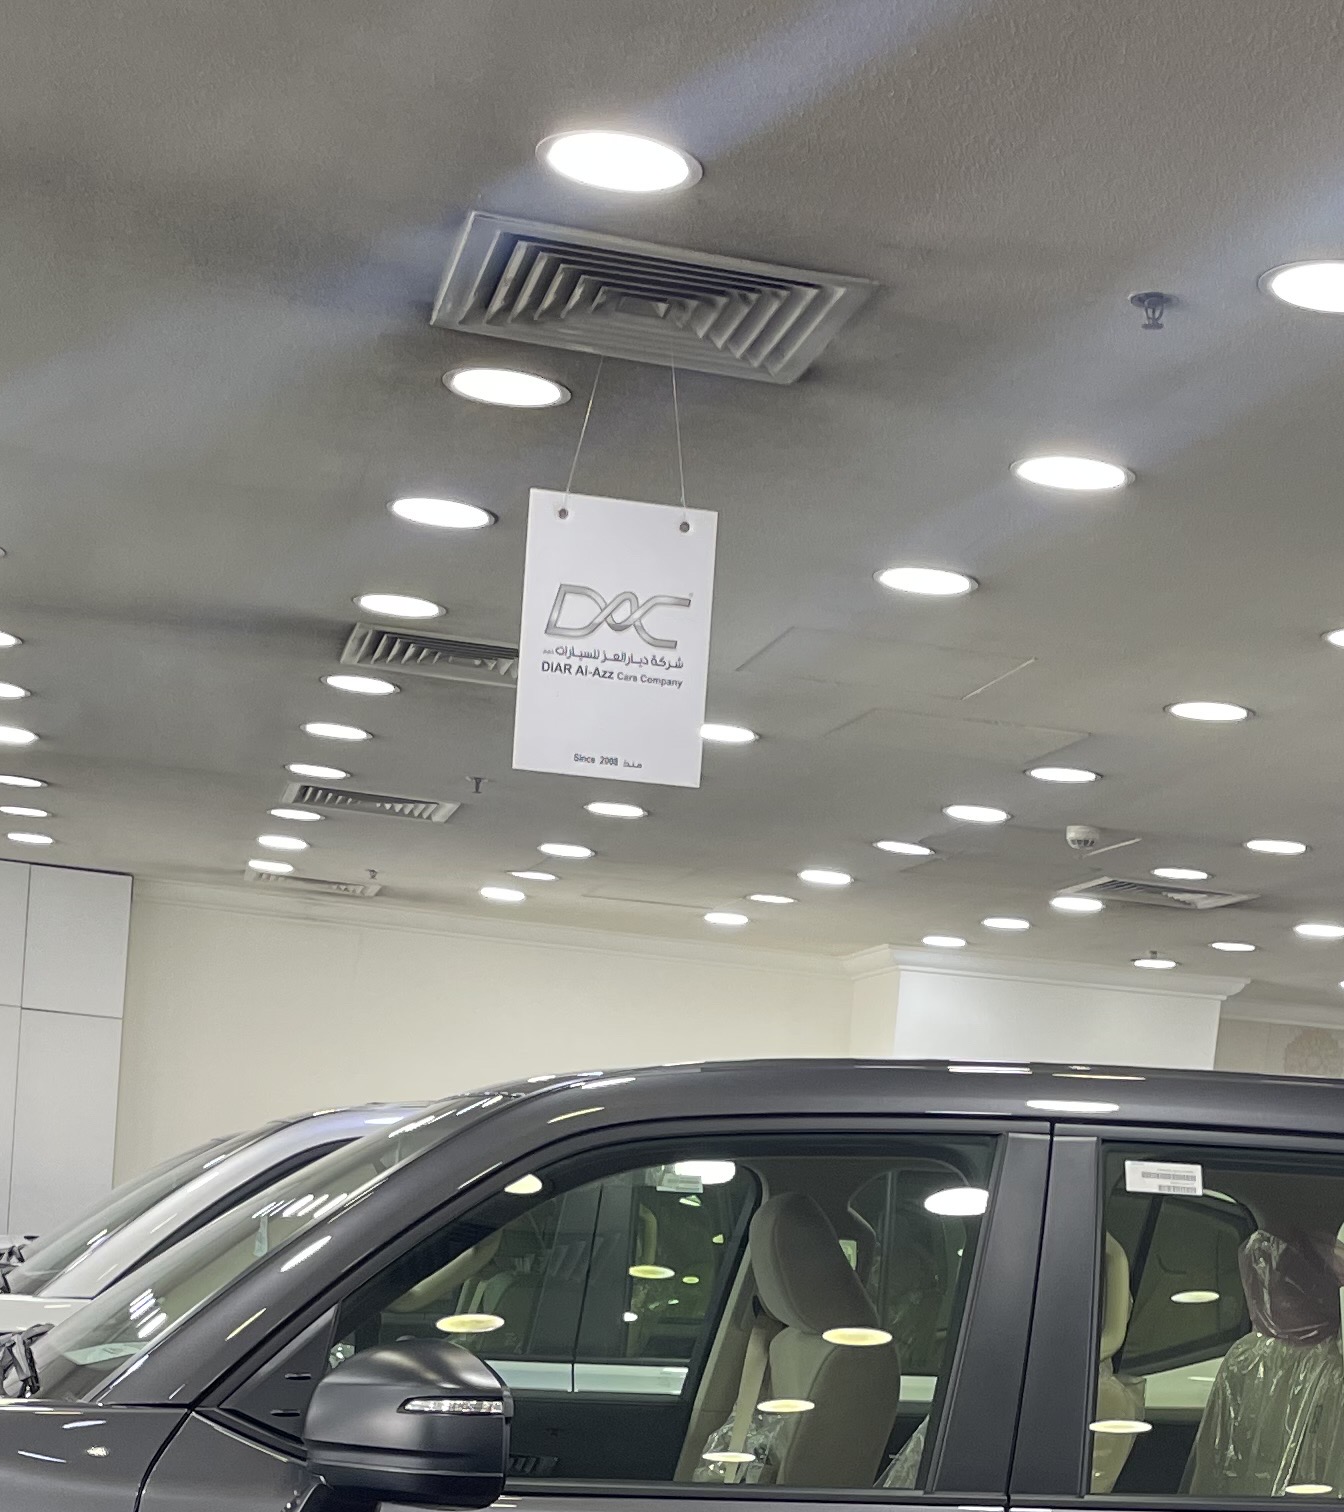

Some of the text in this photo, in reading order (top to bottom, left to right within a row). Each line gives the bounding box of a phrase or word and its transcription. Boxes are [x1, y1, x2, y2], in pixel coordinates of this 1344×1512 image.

[555, 645, 601, 661] للسيارات
[650, 655, 684, 671] شركة
[541, 661, 684, 689] DIAR Al-Azz Cars Company
[573, 753, 596, 764] Since
